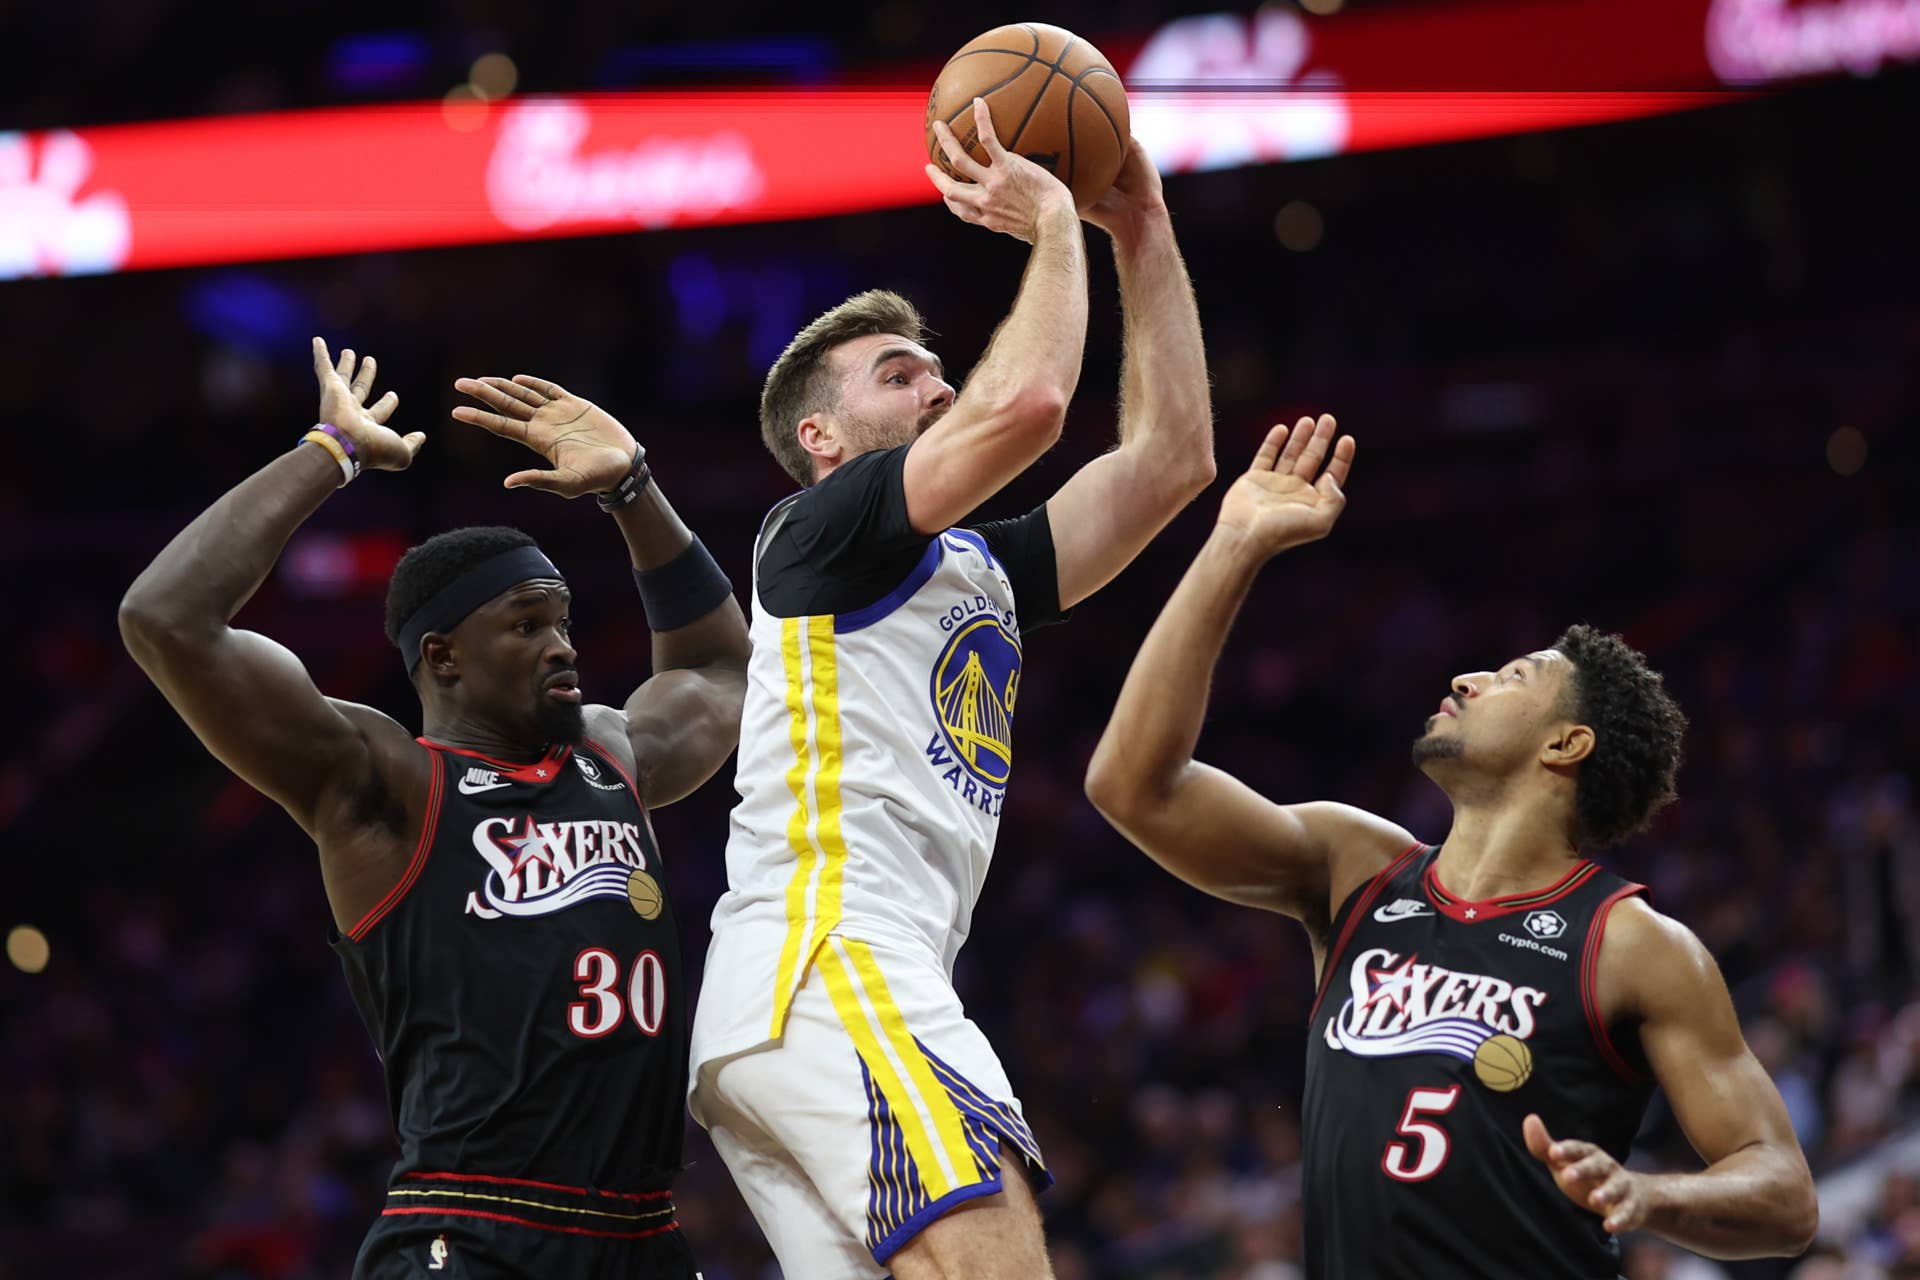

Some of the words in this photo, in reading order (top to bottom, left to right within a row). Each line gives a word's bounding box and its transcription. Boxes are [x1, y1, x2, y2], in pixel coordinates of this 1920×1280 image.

[465, 767, 499, 786] NIKE
[464, 814, 647, 920] SIXERS
[567, 947, 668, 1038] 30
[1498, 933, 1568, 961] crypto.com
[1324, 948, 1547, 1051] SIXERS
[1381, 1084, 1461, 1182] 5
